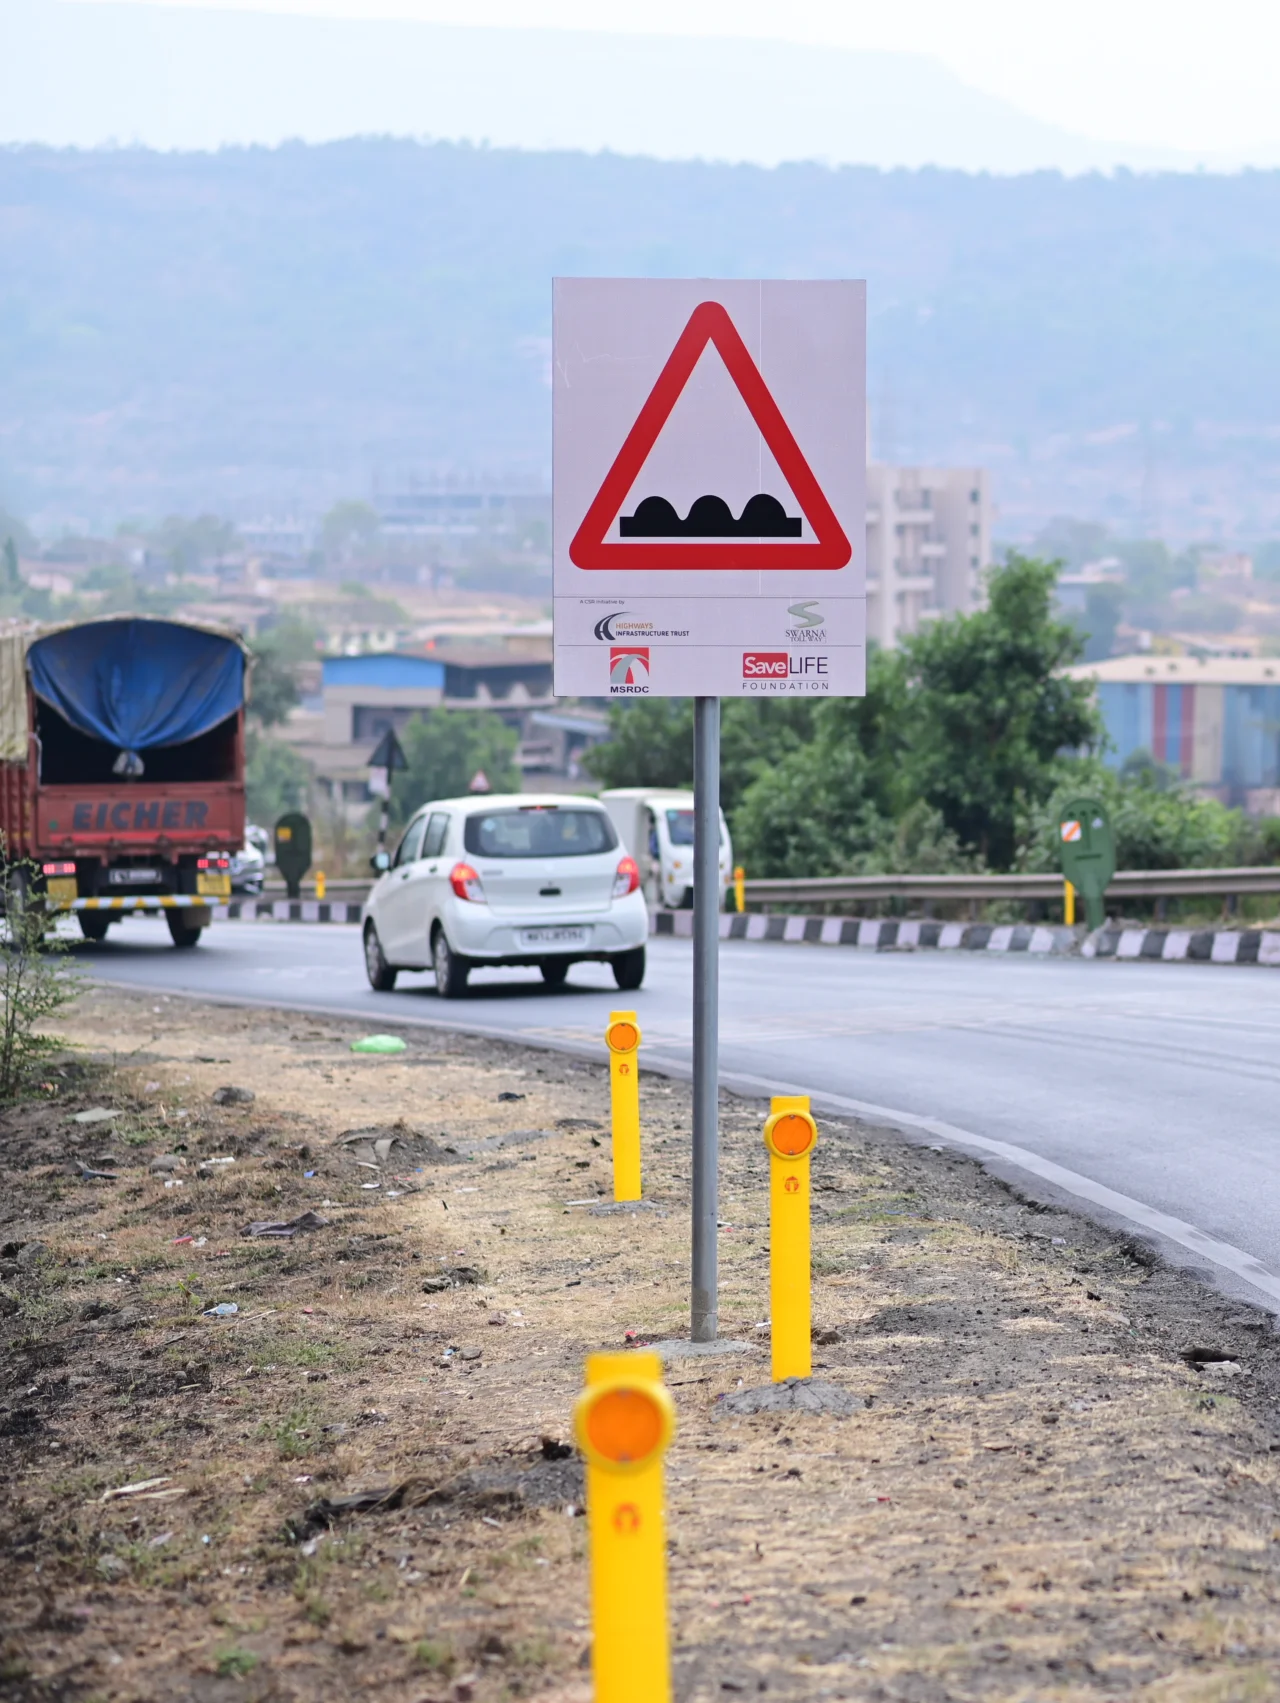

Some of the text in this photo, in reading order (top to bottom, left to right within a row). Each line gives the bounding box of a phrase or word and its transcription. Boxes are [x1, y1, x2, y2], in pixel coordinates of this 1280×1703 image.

[785, 629, 827, 637] SWARNA
[742, 682, 829, 690] FOUNDATION
[73, 801, 209, 830] EICHER
